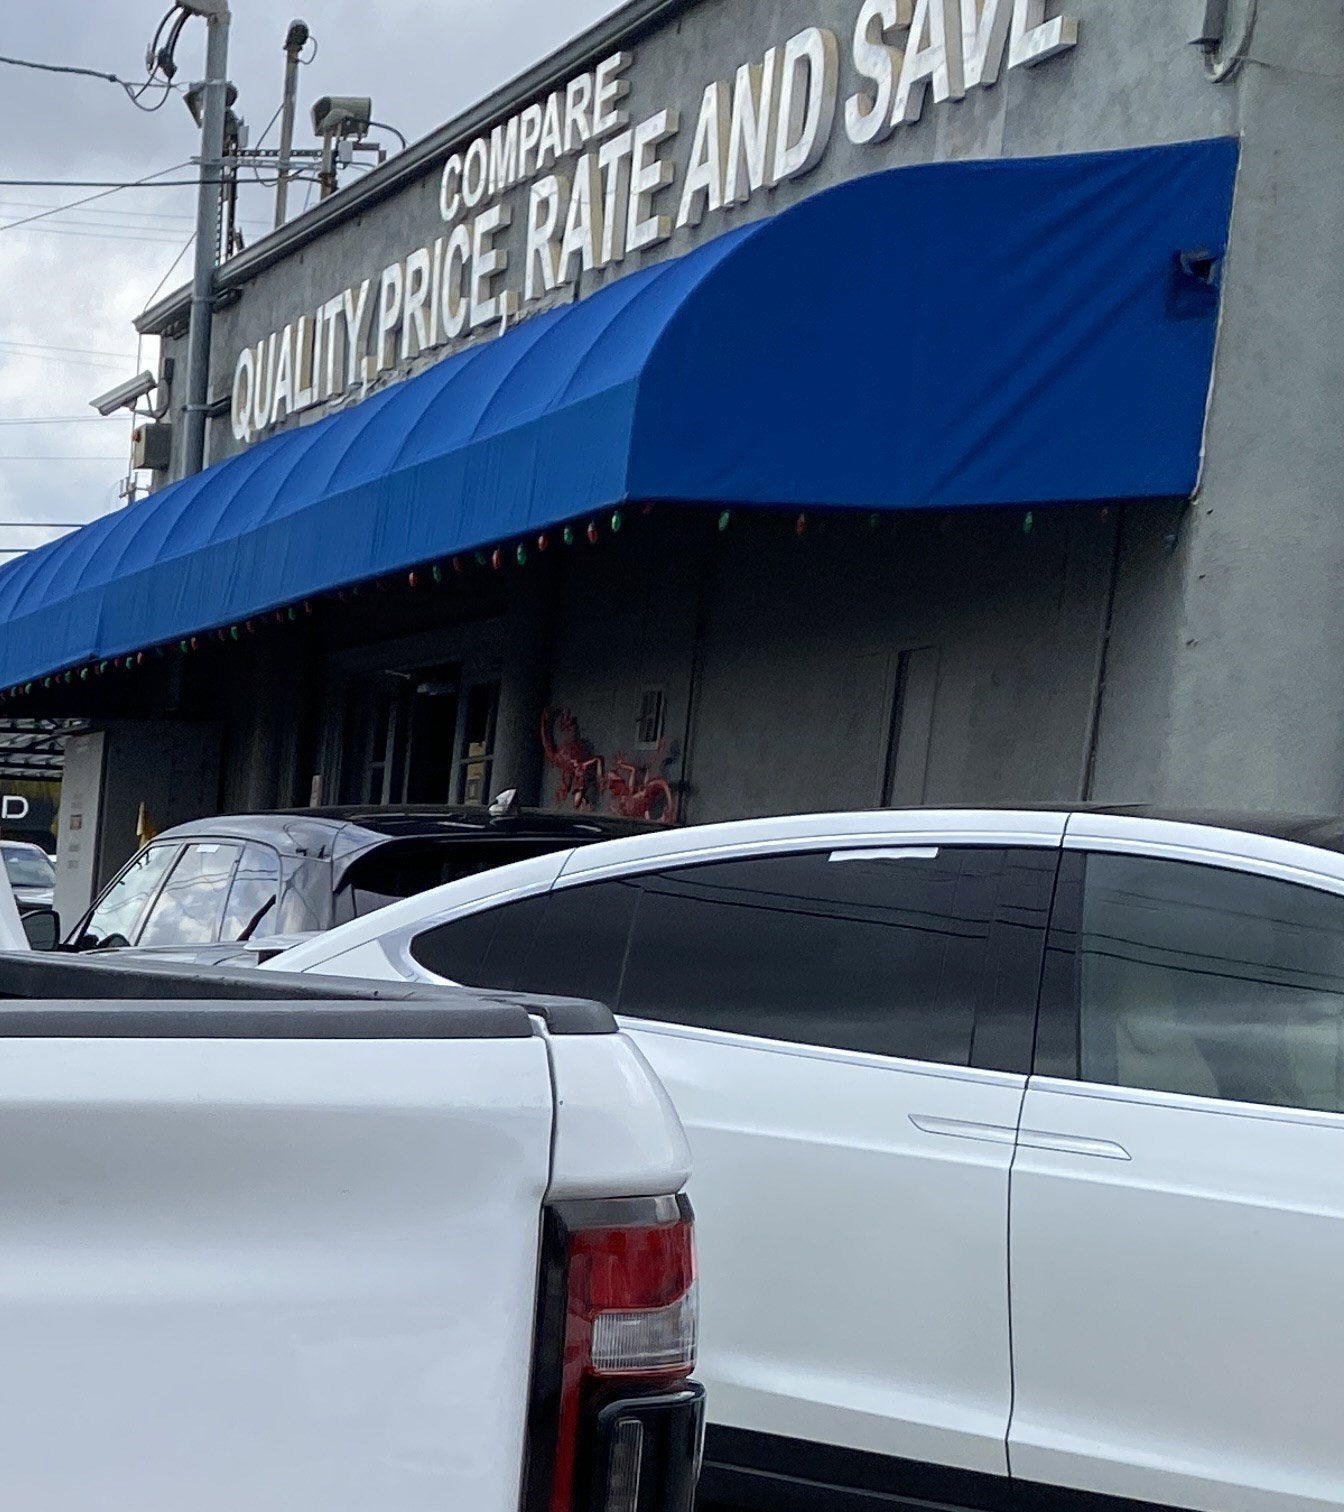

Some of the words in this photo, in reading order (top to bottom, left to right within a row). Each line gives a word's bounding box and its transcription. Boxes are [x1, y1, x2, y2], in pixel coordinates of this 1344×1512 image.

[231, 279, 376, 443] QUALITY,
[377, 204, 512, 337] PRICE,
[525, 108, 679, 302] RATE
[676, 27, 838, 229] AND
[440, 51, 631, 222] COMPARE
